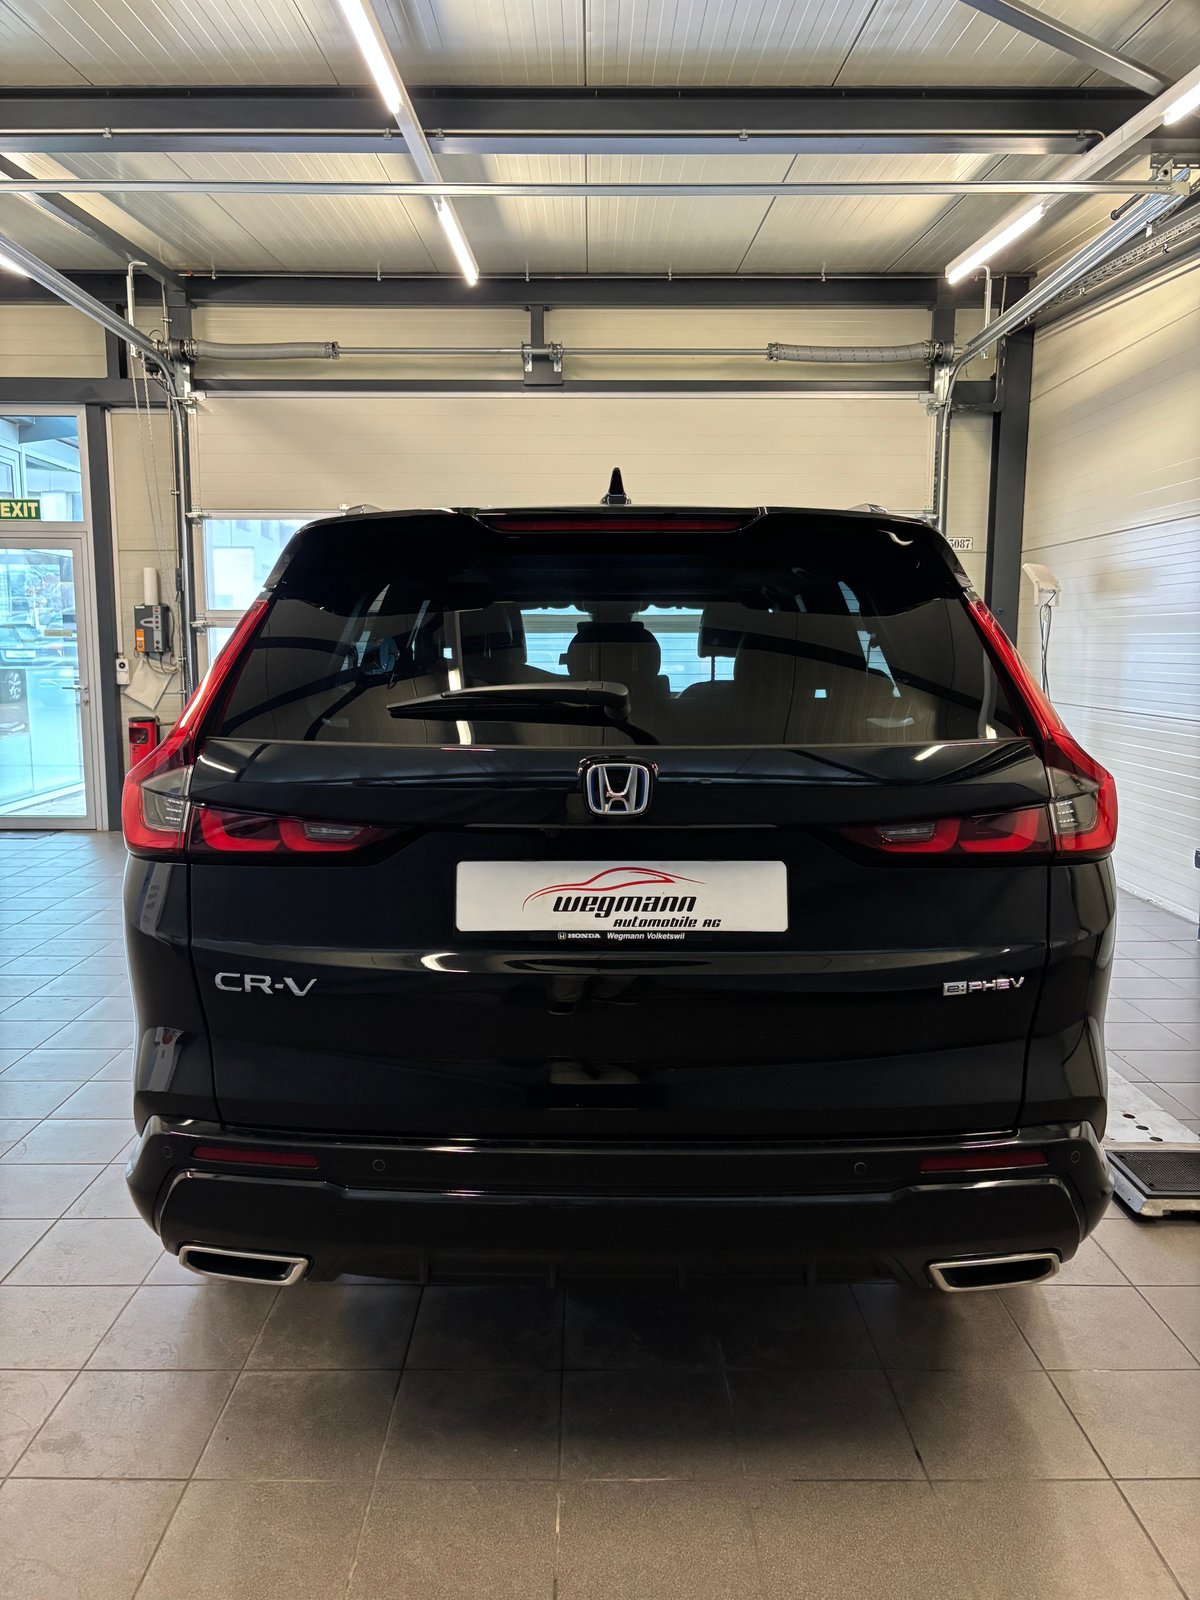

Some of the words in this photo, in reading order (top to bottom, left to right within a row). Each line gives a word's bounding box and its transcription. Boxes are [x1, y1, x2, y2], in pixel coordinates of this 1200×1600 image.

[0, 502, 38, 517] EXIT
[553, 896, 697, 918] wegmann
[702, 919, 721, 928] AG
[607, 932, 645, 941] Wegmann
[646, 932, 685, 940] Volketswil
[214, 972, 318, 997] CR-V
